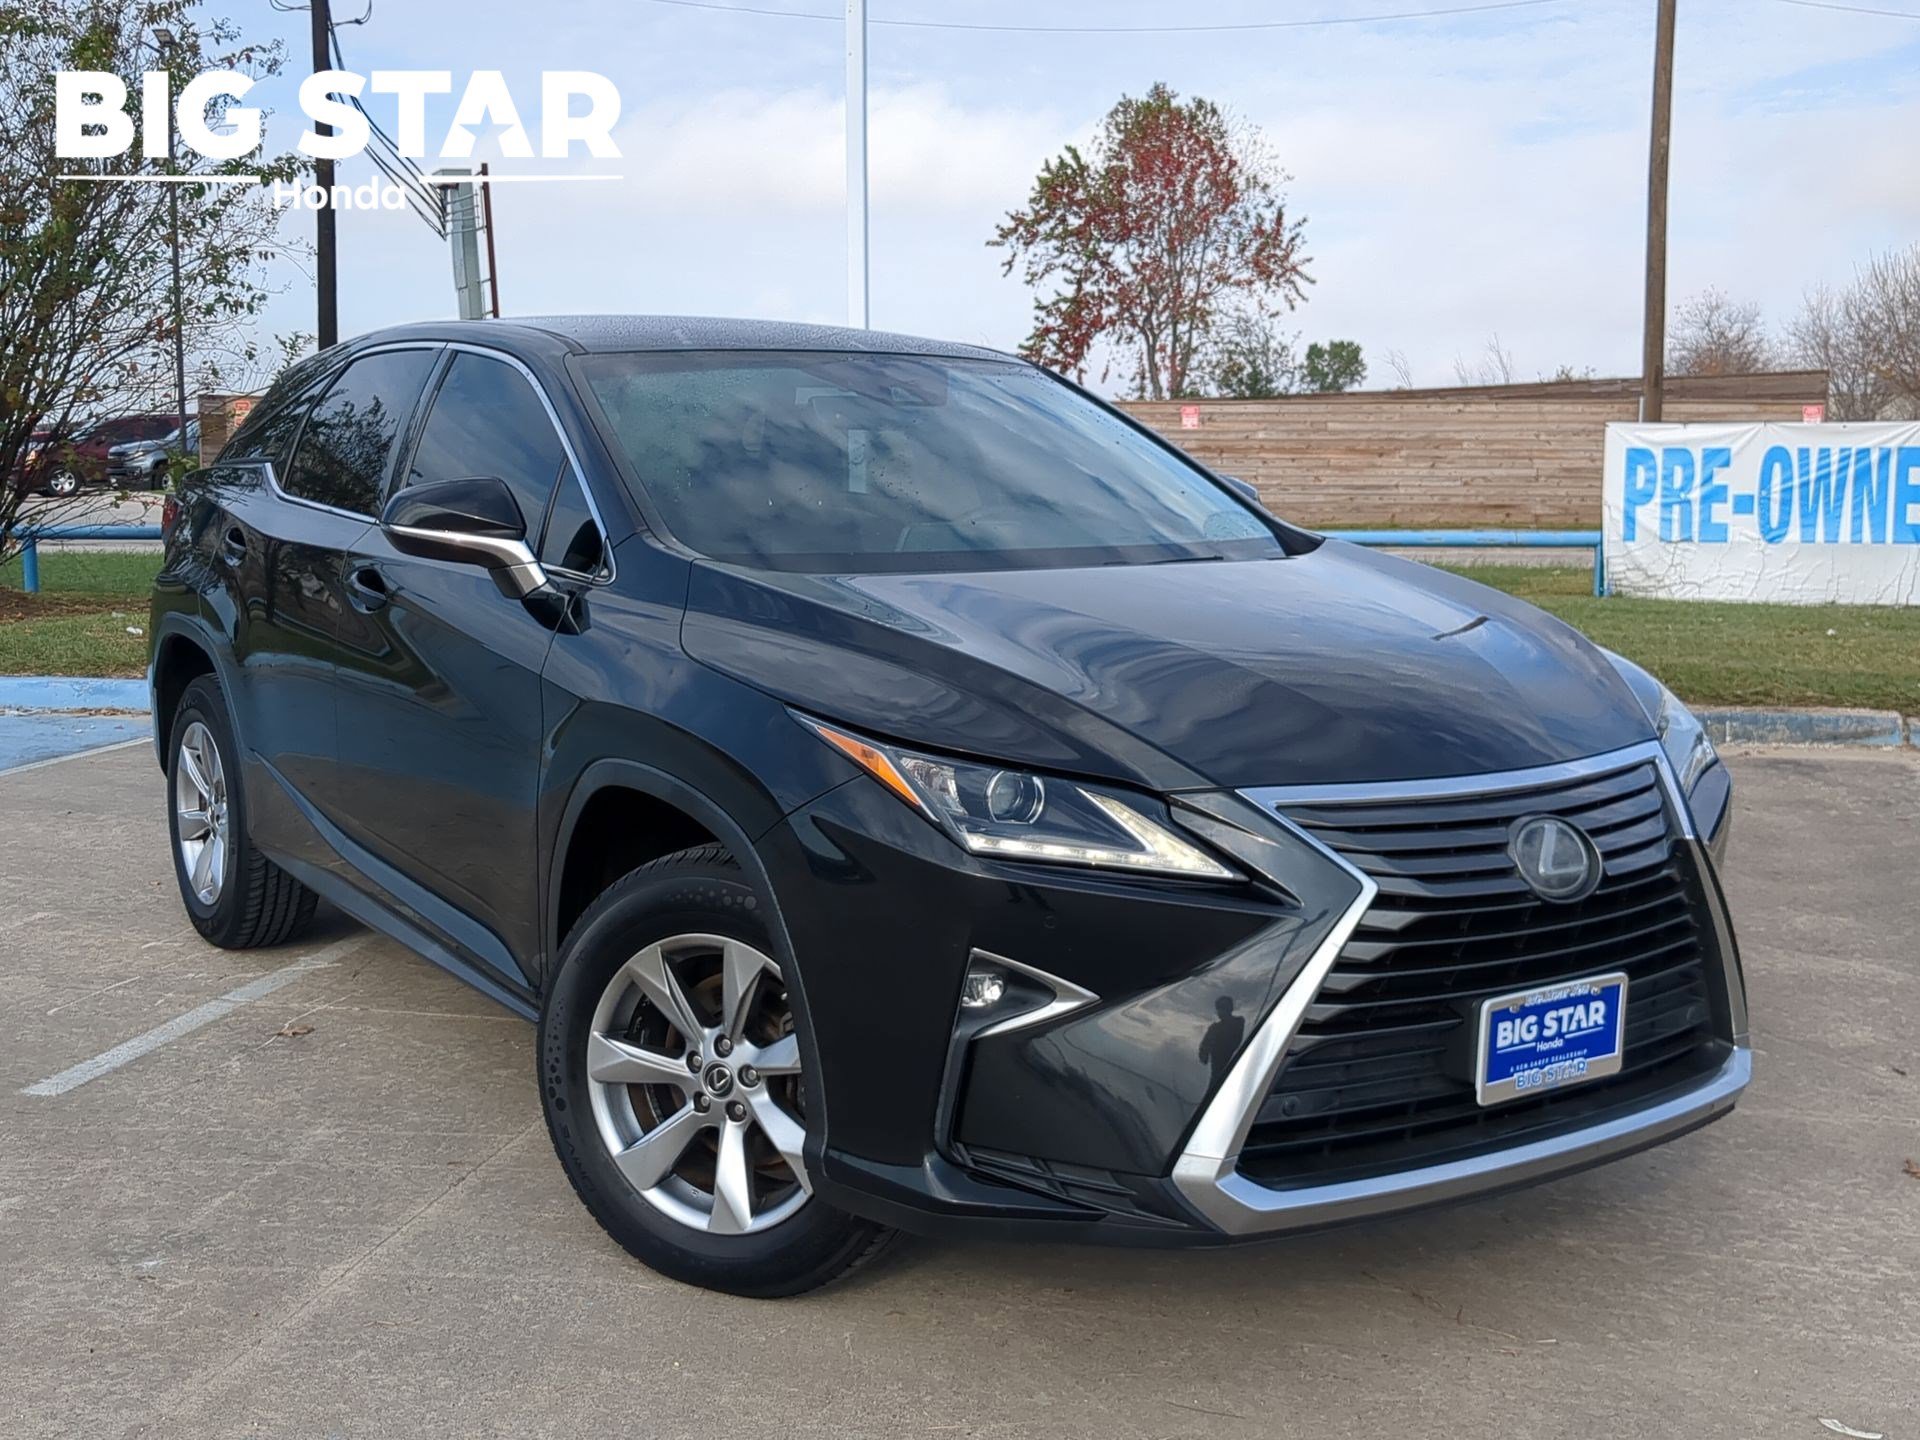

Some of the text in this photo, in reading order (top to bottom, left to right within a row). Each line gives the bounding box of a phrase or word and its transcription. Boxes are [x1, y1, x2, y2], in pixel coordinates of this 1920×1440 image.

[1496, 1000, 1606, 1049] BIG STAR
[1536, 1036, 1564, 1052] Honda
[1515, 1070, 1541, 1089] BIG
[1545, 1058, 1587, 1080] STAR
